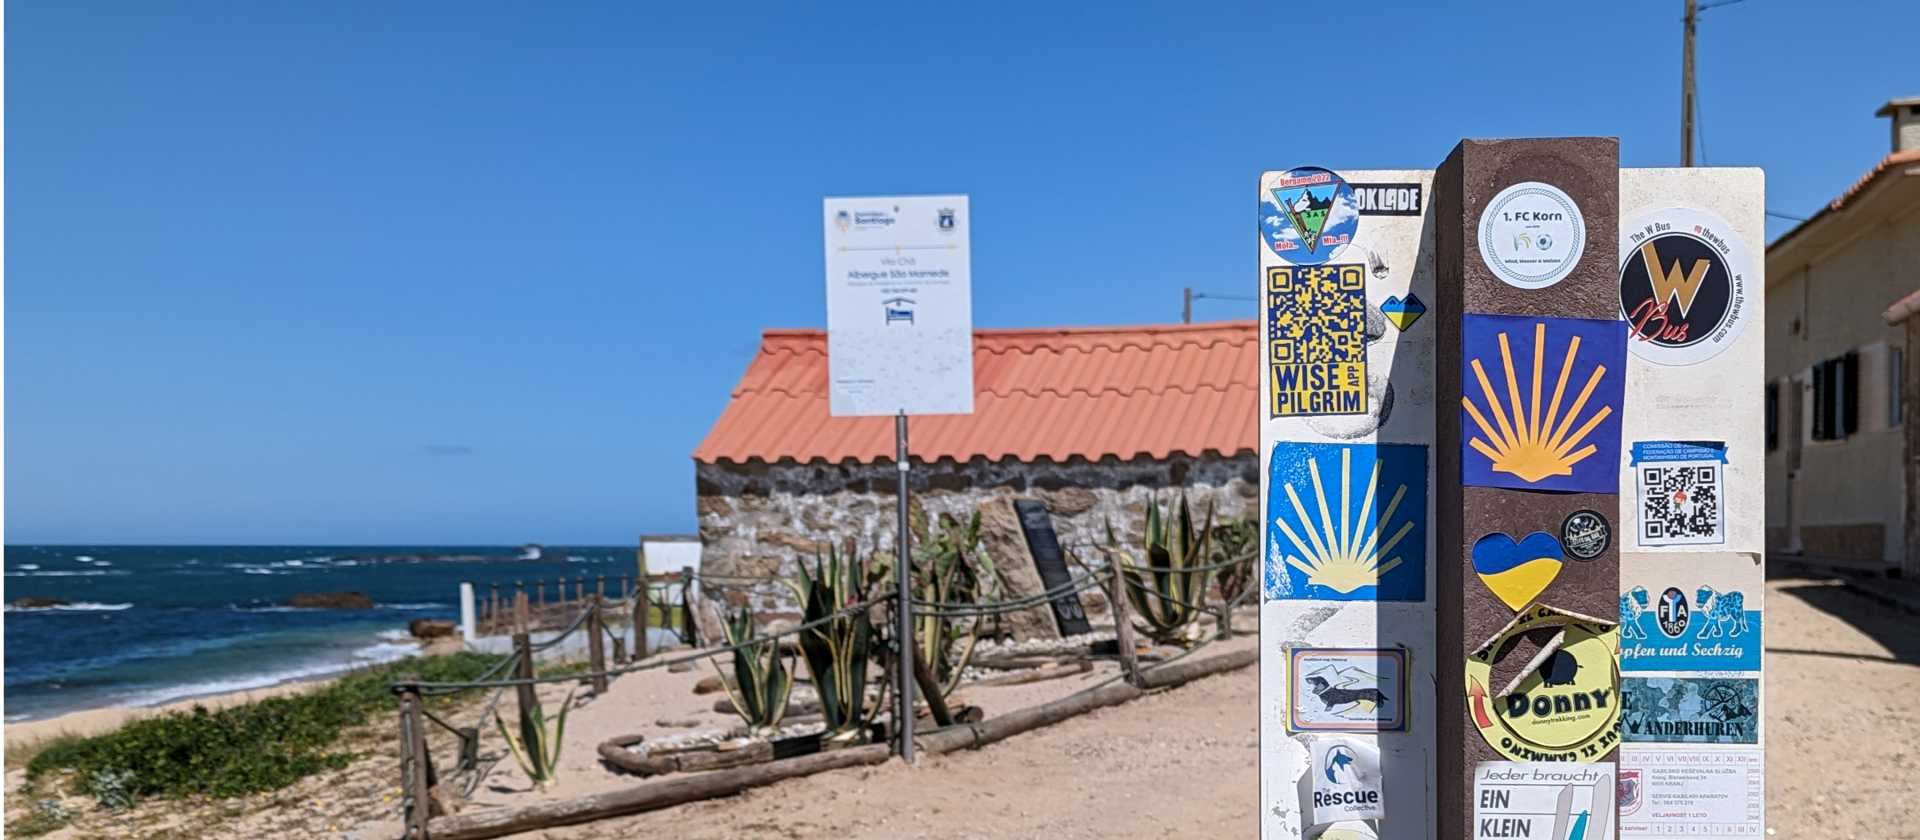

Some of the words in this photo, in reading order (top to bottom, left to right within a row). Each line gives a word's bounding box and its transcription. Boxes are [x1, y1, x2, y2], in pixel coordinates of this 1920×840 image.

[1503, 213, 1512, 222] 1.
[1515, 212, 1530, 221] FC
[1533, 212, 1562, 221] Korn
[1630, 229, 1646, 243] The
[1645, 225, 1654, 235] W
[1655, 222, 1671, 231] Bus
[1702, 228, 1730, 255] thewbus
[1640, 241, 1711, 319] W
[1712, 274, 1744, 344] www.thewbus.com
[1630, 298, 1690, 342] Bus
[1275, 364, 1340, 391] WISE
[1347, 366, 1359, 387] APP
[1277, 390, 1360, 413] PILGRIM
[1662, 620, 1686, 634] 1860
[1660, 643, 1688, 657] und
[1691, 642, 1744, 659] Sechzig
[1501, 737, 1577, 762] CAMMINO
[1481, 768, 1528, 780] Jeder
[1533, 768, 1598, 781] braucht
[1314, 790, 1378, 808] Rescue
[1480, 789, 1510, 809] EIN
[1480, 818, 1531, 838] KLEIN
